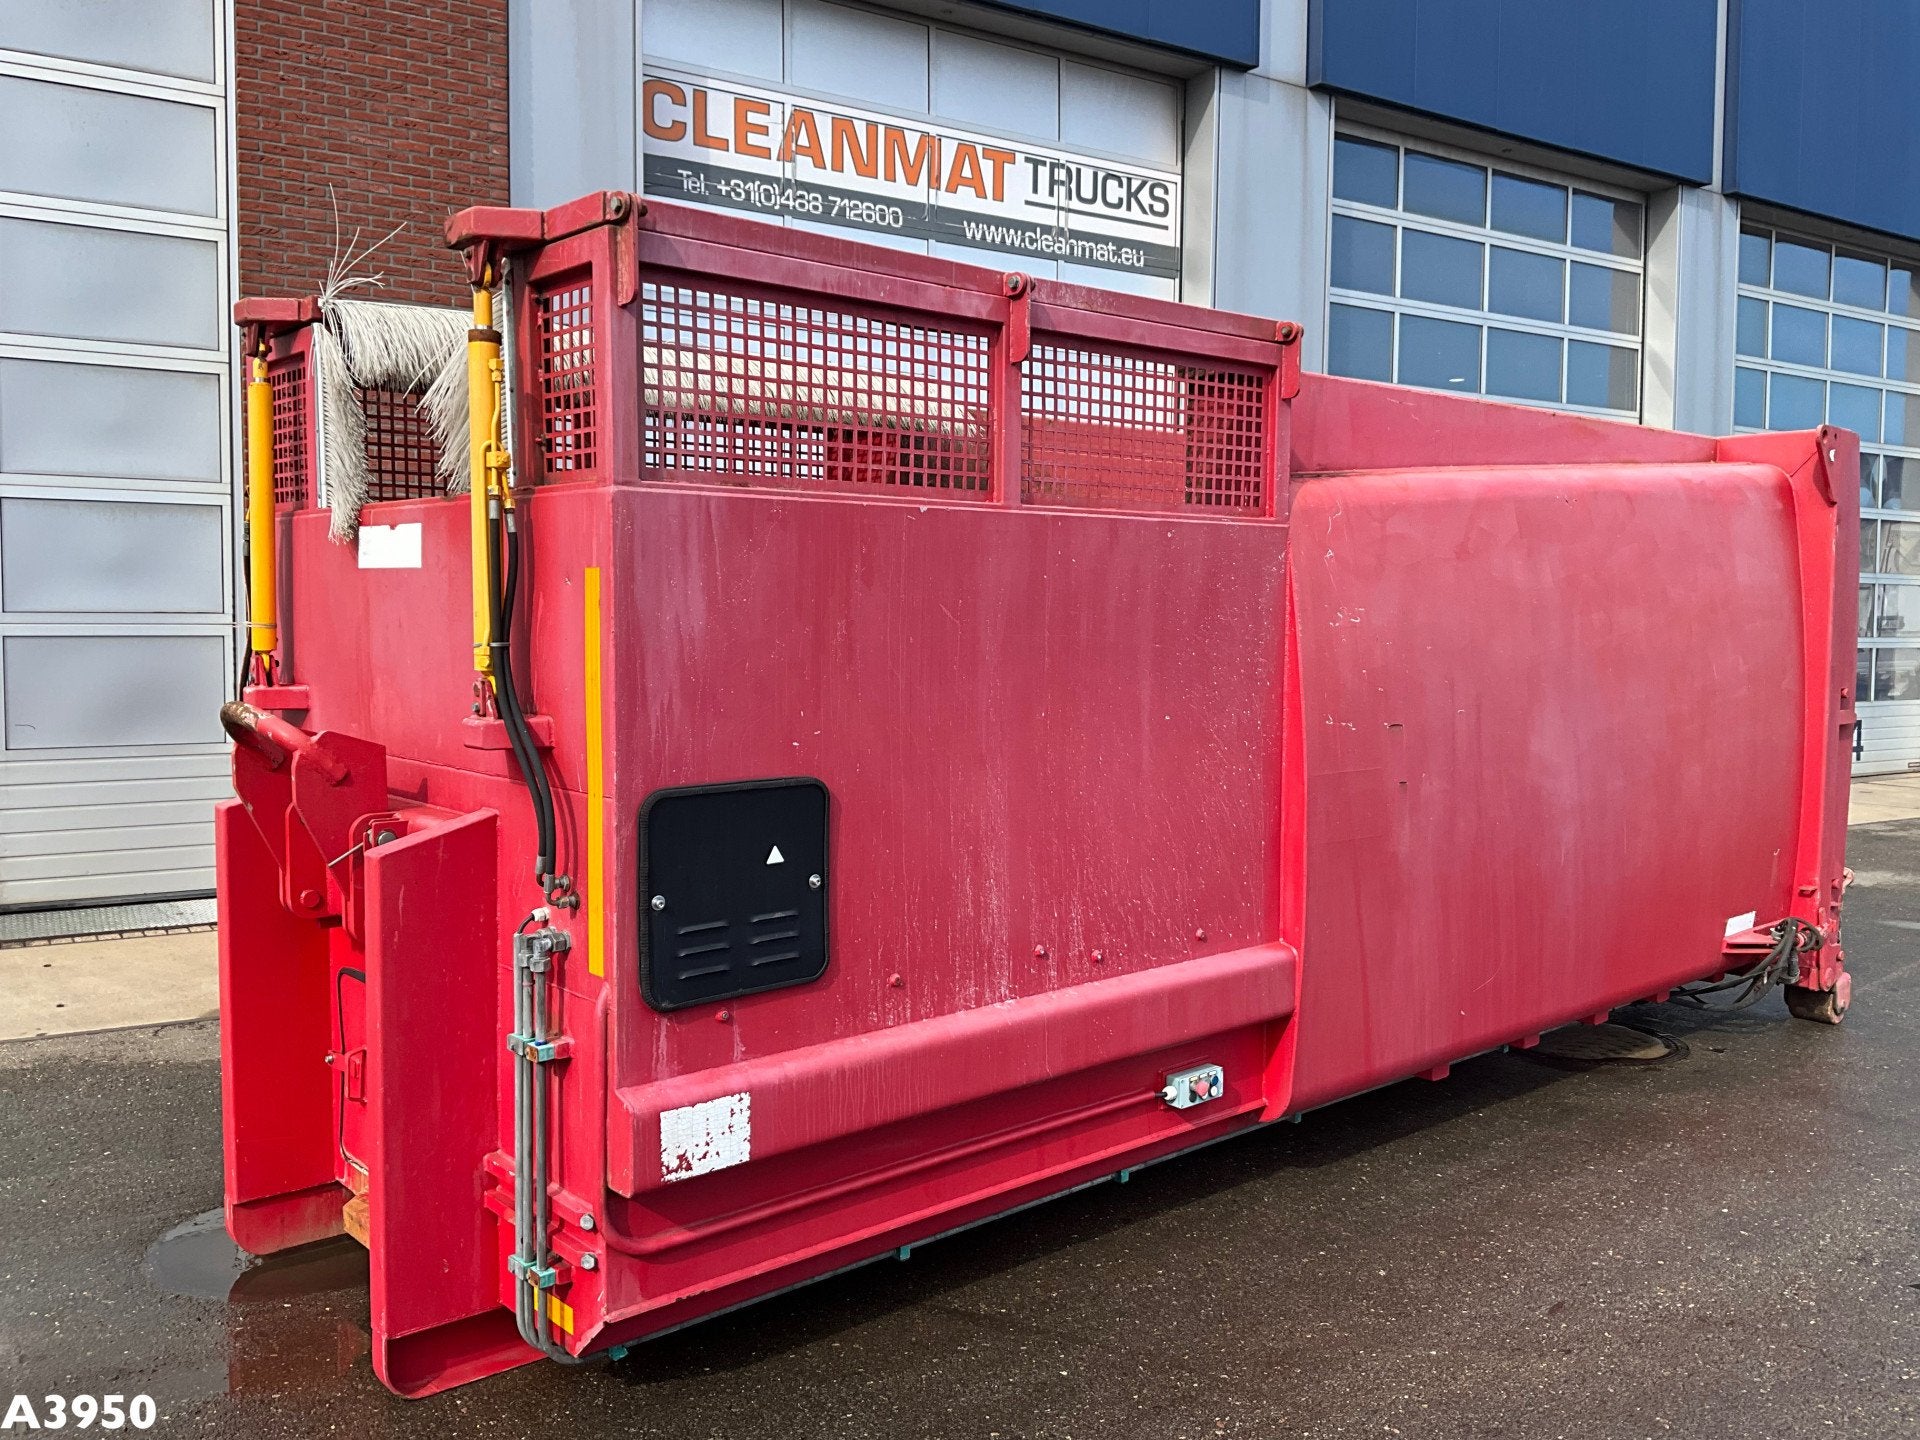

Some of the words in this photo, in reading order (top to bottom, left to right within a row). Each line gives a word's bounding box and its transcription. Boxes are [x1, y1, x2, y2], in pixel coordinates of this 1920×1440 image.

[643, 78, 1016, 203] CLEANMAT
[1024, 156, 1169, 219] TRUCKS
[677, 169, 709, 196] Tel.
[828, 195, 903, 228] 712600
[963, 220, 1145, 268] www.cleanmat.eu
